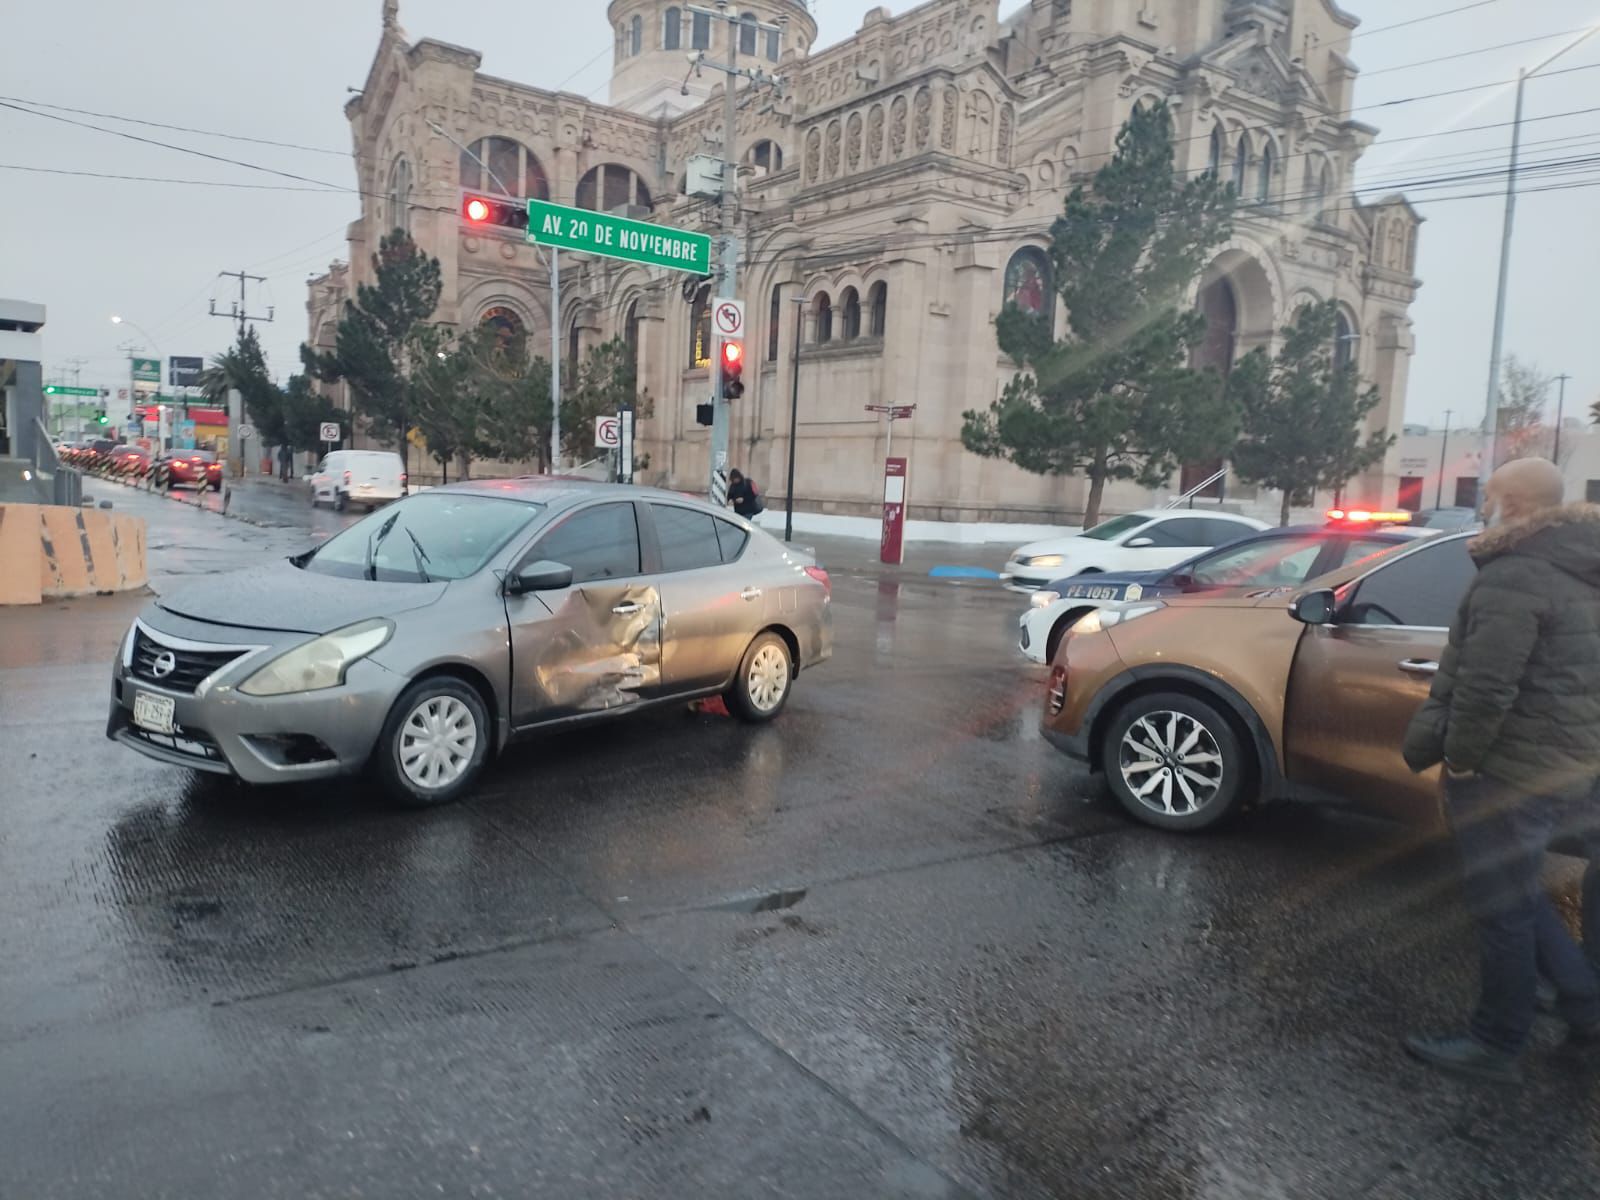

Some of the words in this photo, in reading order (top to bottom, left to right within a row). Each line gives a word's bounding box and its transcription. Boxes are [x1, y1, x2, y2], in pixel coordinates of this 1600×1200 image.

[542, 213, 563, 236] AV.
[595, 224, 613, 245] DE
[619, 228, 698, 261] NOVIEMBRE
